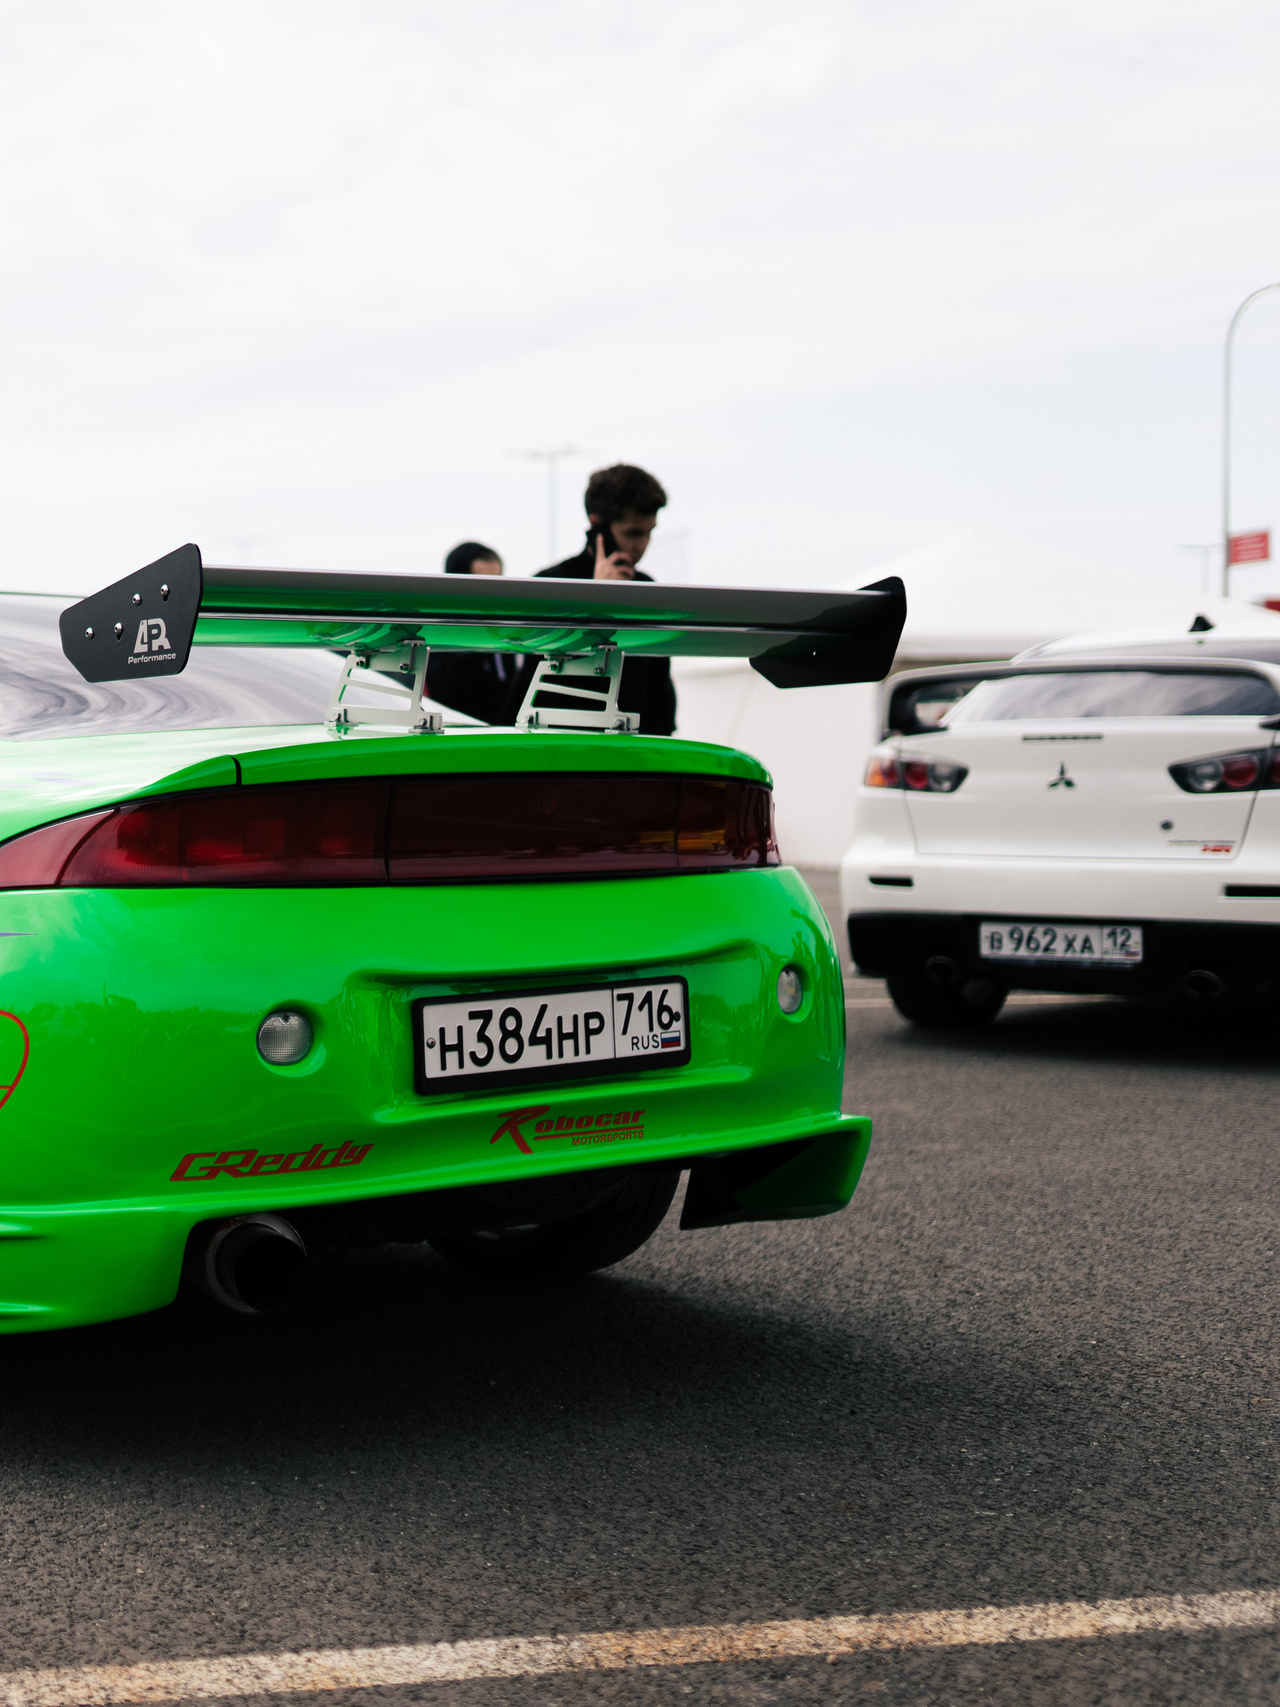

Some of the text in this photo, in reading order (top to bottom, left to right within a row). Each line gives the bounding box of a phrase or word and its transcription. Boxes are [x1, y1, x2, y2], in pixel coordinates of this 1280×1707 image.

[128, 653, 176, 664] Performance
[1106, 927, 1132, 949] 12
[616, 988, 675, 1036] 716
[631, 1033, 660, 1051] RUS
[489, 1104, 646, 1155] Robocar
[571, 1130, 645, 1147] MOTORSPORTS
[169, 1139, 375, 1182] GReddy
